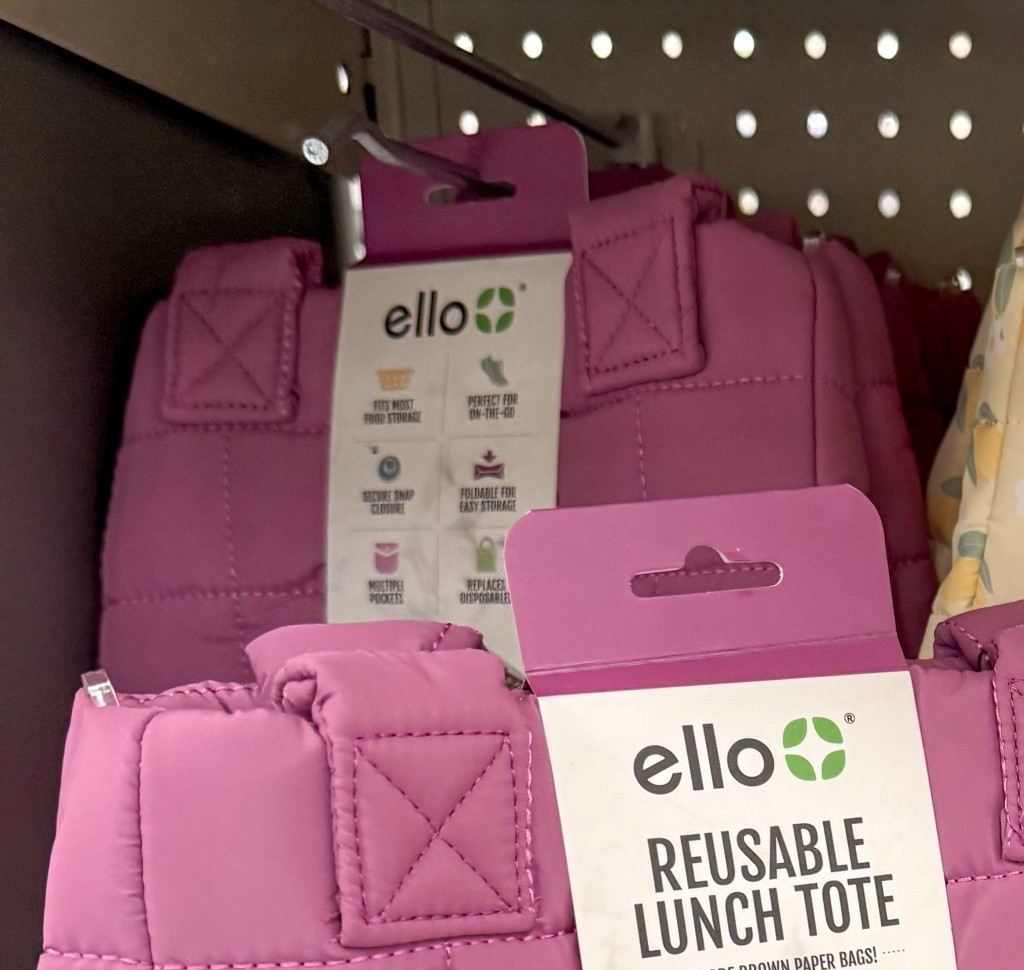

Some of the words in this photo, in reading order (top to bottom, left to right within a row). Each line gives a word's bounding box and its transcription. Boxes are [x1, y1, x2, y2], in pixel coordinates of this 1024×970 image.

[385, 290, 468, 340] ello
[373, 400, 391, 411] FITS
[392, 399, 414, 410] MOST
[467, 395, 501, 407] PERFECT
[503, 394, 518, 406] FOR
[364, 413, 385, 425] FOOD
[387, 412, 421, 423] STORAGE
[469, 407, 515, 420] ON-THE-GO
[363, 491, 392, 502] SECURE
[394, 490, 415, 502] SNAP
[460, 487, 498, 499] FOLDABLE
[501, 487, 517, 498] FOR
[371, 503, 405, 515] CLOSURE
[459, 501, 479, 513] EASY
[481, 500, 517, 512] STORAGE
[369, 593, 403, 604] POCKETS
[633, 722, 775, 795] ello
[647, 816, 870, 893] REUSABLE
[634, 888, 785, 959] LUNCH
[794, 873, 900, 937] TOTE
[839, 947, 878, 969] BAGS!
